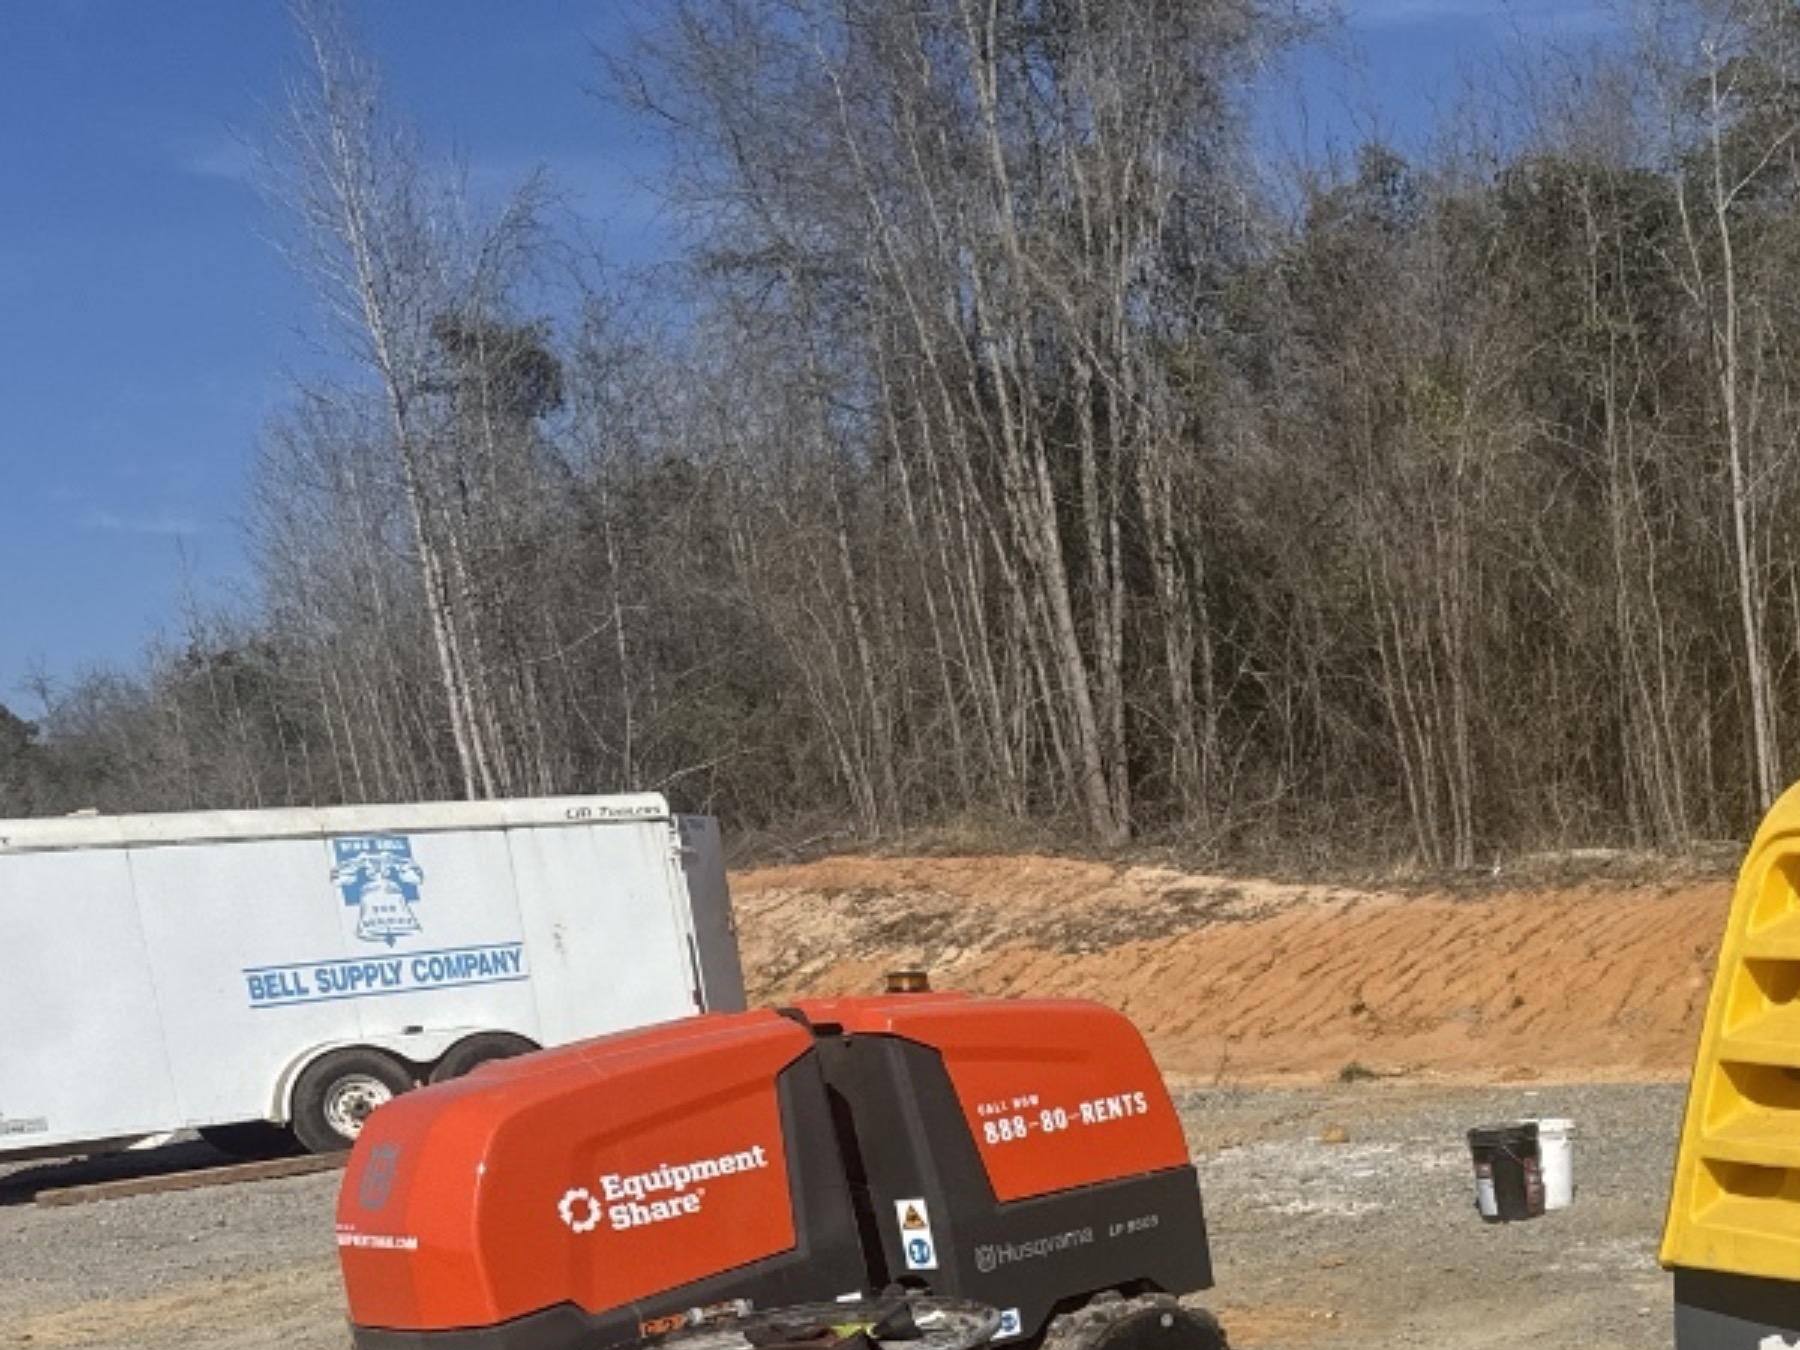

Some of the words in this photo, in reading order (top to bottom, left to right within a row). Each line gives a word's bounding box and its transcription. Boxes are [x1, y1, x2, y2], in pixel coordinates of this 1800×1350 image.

[247, 971, 309, 1001] BELL
[314, 961, 402, 993] SUPPLY
[410, 948, 523, 982] COMPANY
[983, 1091, 1148, 1144] 888-80-RENTS
[600, 1145, 768, 1201] Equipment
[608, 1193, 702, 1231] Share
[998, 1226, 1095, 1264] Husqvarna
